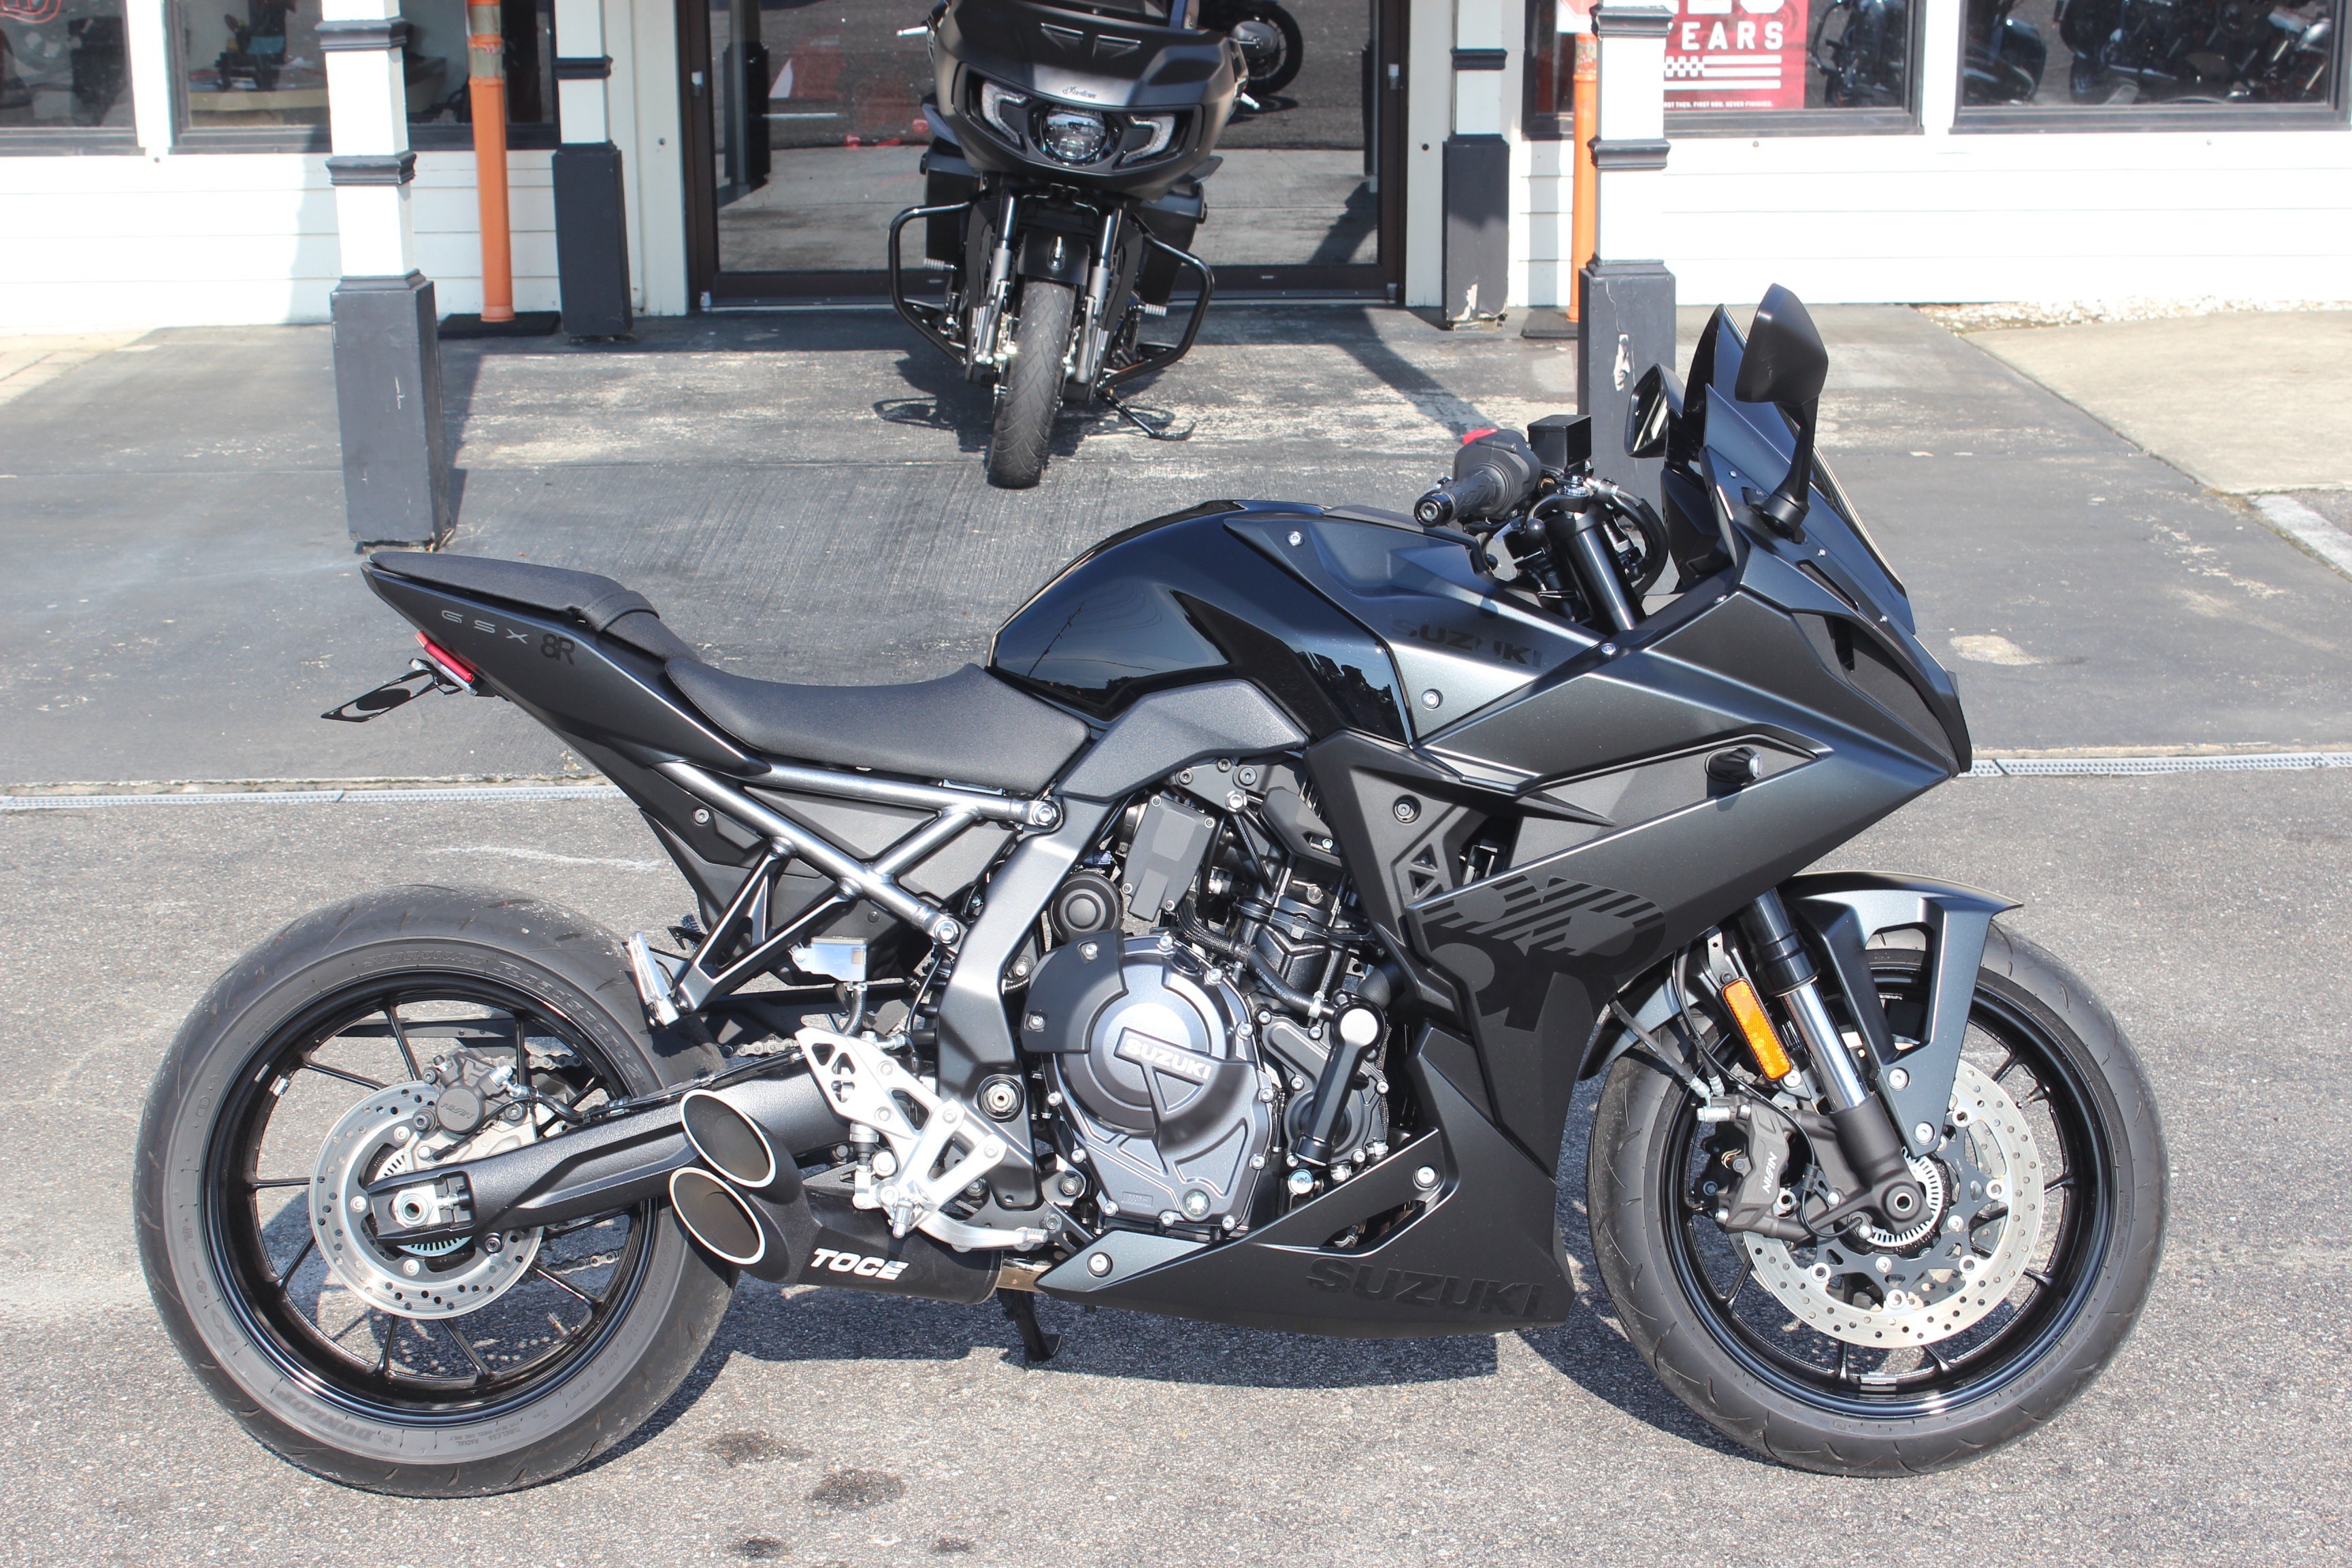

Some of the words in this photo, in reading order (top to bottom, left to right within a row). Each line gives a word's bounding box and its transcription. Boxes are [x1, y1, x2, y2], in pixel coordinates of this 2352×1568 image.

[540, 632, 576, 666] 8R
[1391, 618, 1540, 668] SUZUKI
[1124, 1039, 1211, 1079] SUZUKI
[1761, 1150, 1778, 1195] NISSIN
[810, 1247, 910, 1281] TOCE
[1307, 1256, 1544, 1318] SUZUKI
[273, 1390, 377, 1441] DUNLOP
[488, 1426, 522, 1441] TUBELESS
[457, 1438, 479, 1447] RADIAL
